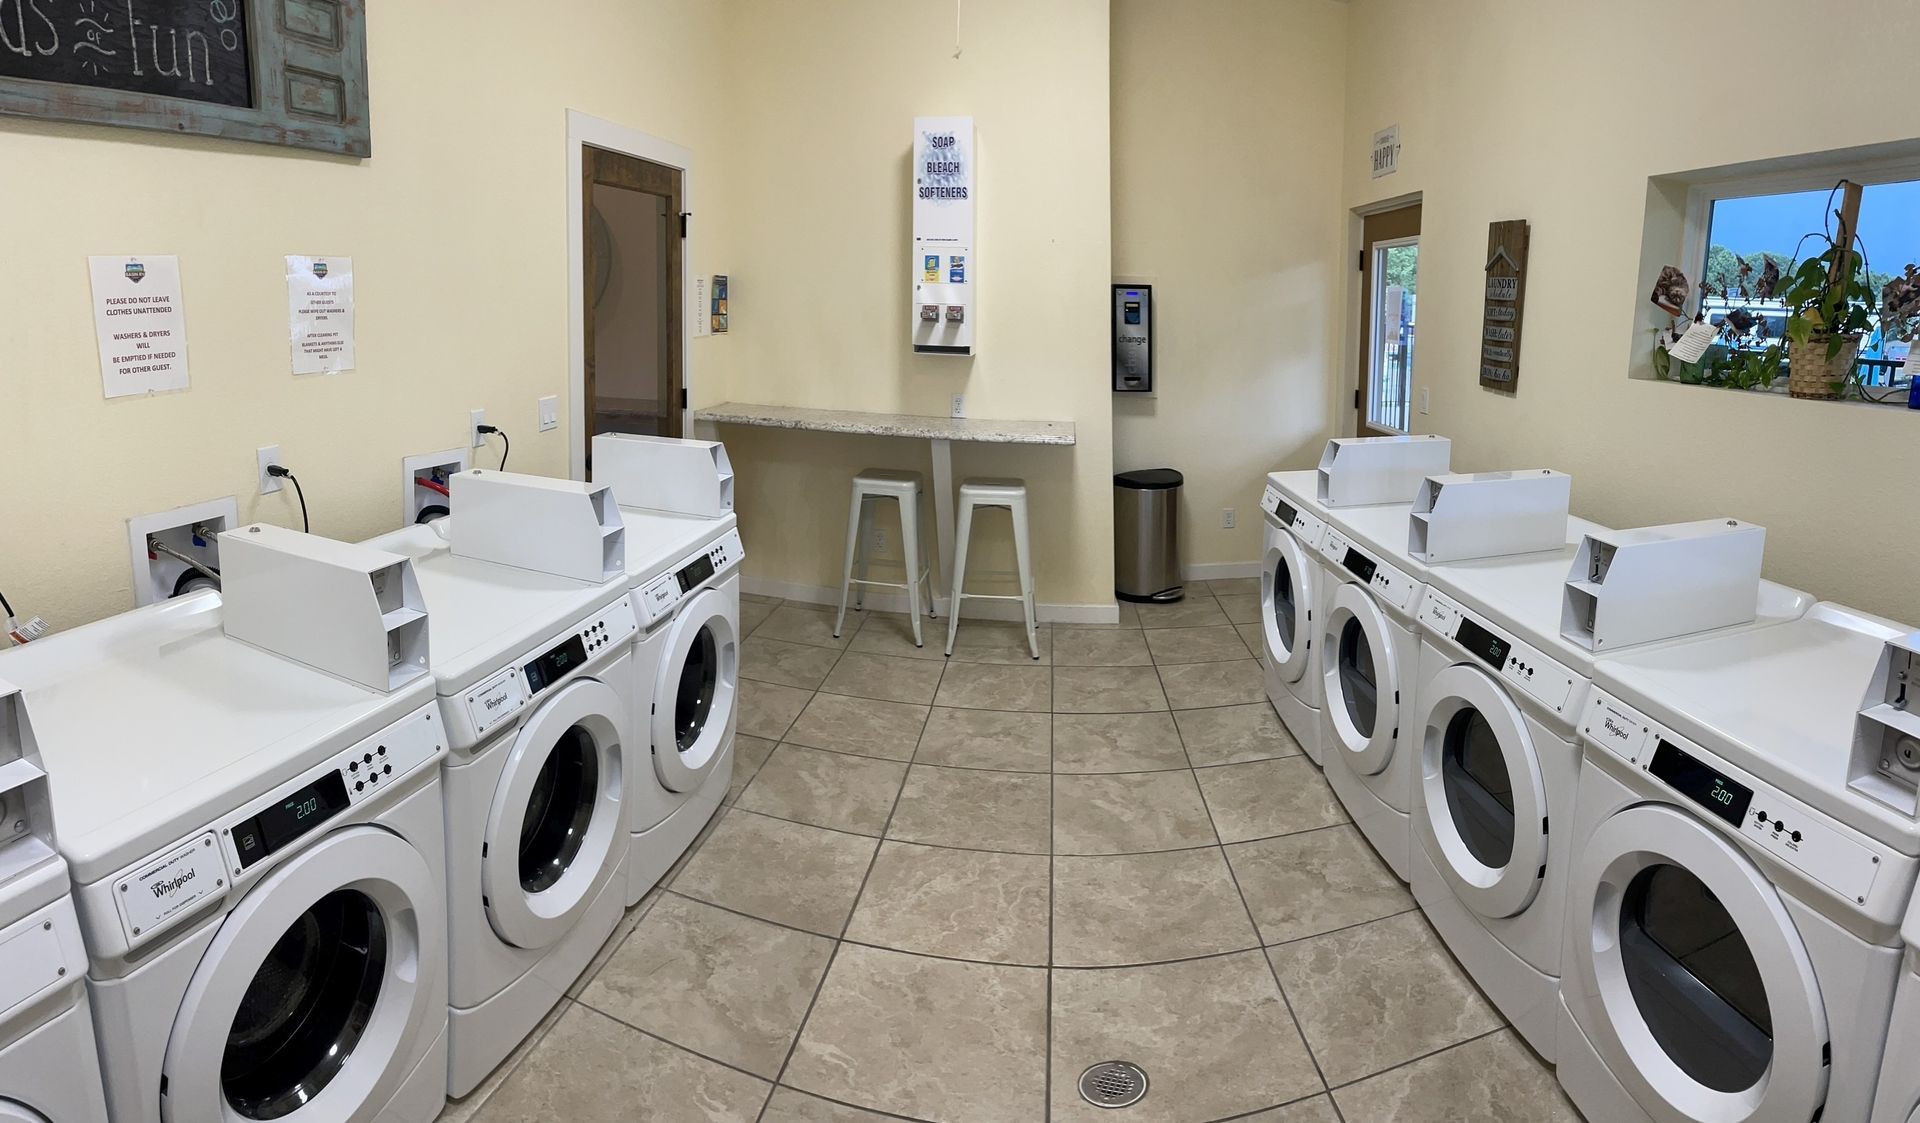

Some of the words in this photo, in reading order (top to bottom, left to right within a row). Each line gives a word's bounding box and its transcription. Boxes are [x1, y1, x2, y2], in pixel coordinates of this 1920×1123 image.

[932, 136, 955, 148] SOAP
[1373, 143, 1396, 171] HAPPY
[927, 161, 960, 173] BLEACH
[919, 186, 968, 199] SOFTENERS
[138, 296, 151, 304] NOT
[152, 295, 170, 303] LEAVE
[106, 308, 132, 316] CLOTHES
[133, 306, 172, 315] UNATTENDED
[113, 332, 142, 340] WASHERS
[149, 330, 171, 338] DRYERS
[1118, 334, 1147, 346] change
[121, 354, 146, 363] EMPTIED
[154, 351, 176, 360] NEEDED
[119, 367, 131, 375] FOR
[132, 365, 151, 374] OTHER
[152, 363, 172, 371] GUEST.
[1605, 721, 1629, 740] Whirlpool
[1710, 786, 1733, 806] 2.00
[296, 797, 317, 820] 2.00
[139, 863, 168, 881] COMMERCIAL
[168, 857, 179, 866] DUTY
[152, 868, 196, 898] Whirlpool
